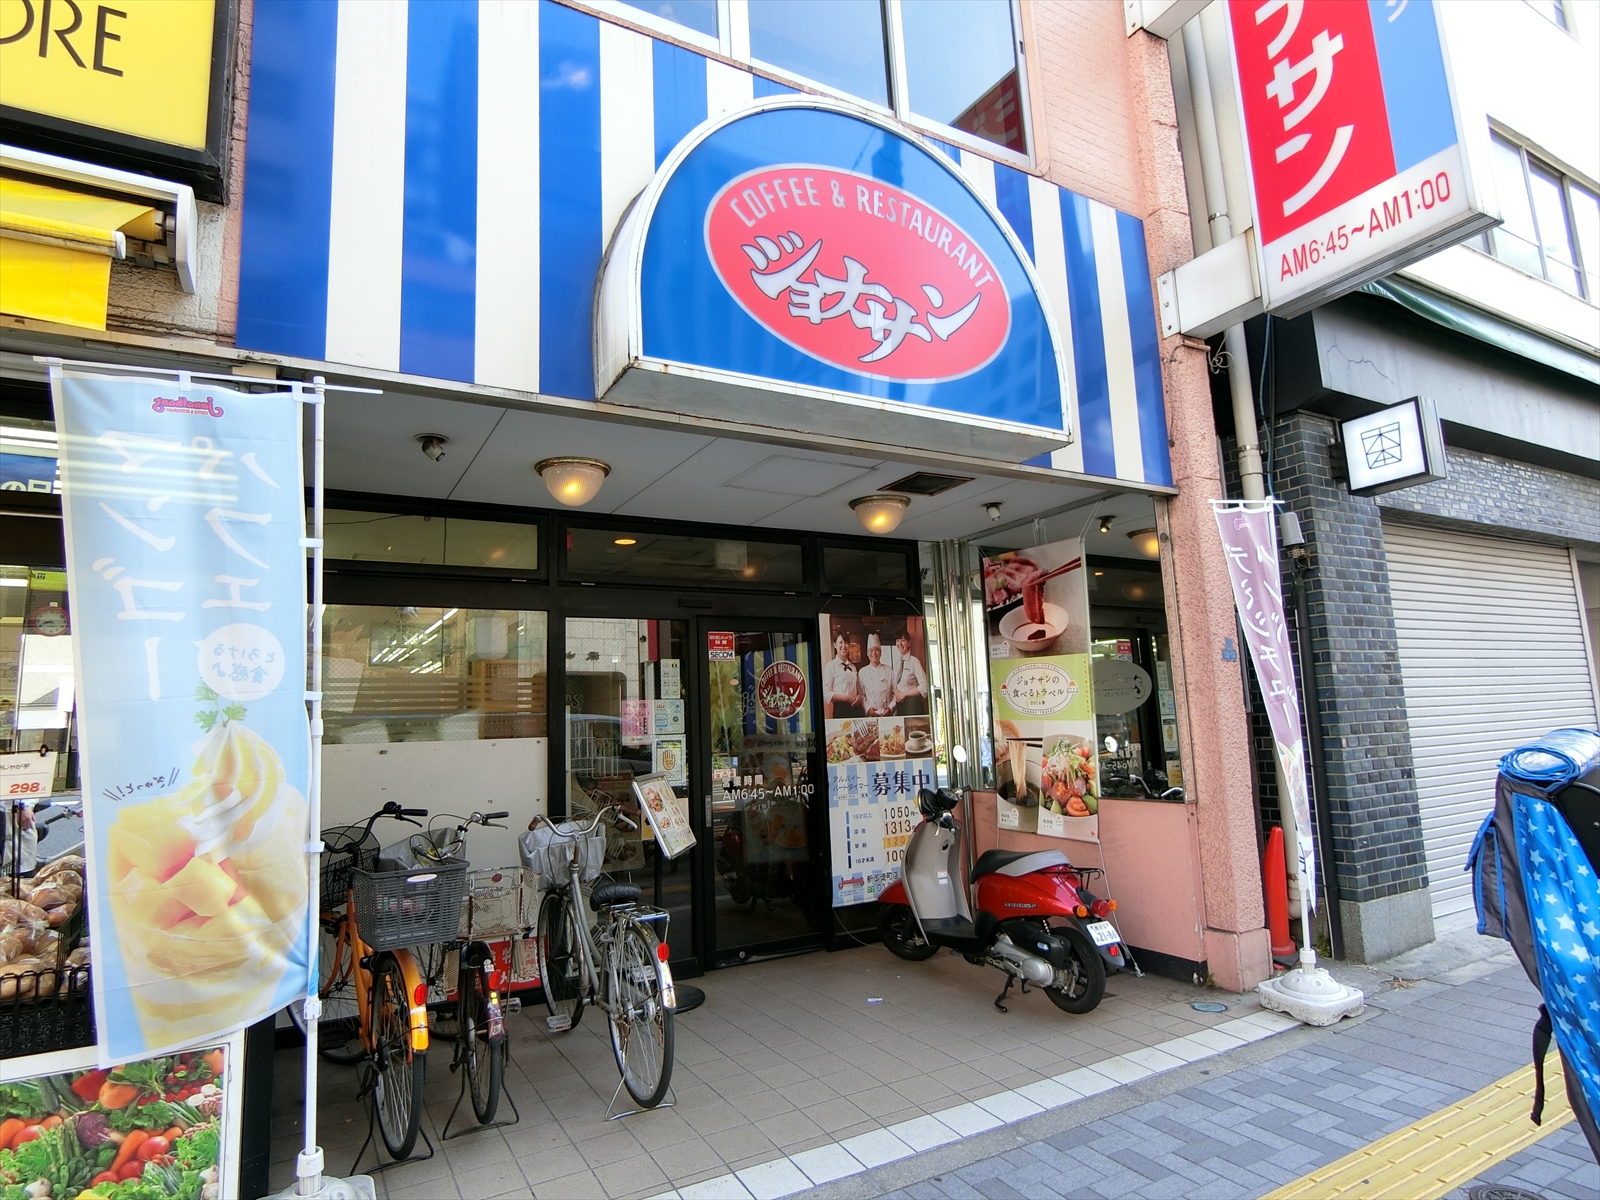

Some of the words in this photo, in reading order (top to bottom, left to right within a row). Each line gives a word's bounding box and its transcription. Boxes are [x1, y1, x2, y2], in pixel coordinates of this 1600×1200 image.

[729, 176, 821, 228] COFFEE
[830, 179, 846, 208] &
[856, 184, 994, 289] RESTAURANT
[740, 230, 982, 363] ジョナサン
[1016, 675, 1060, 686] ジョナサンの
[1012, 688, 1065, 698] 食べるトラベル
[722, 774, 764, 788] 営業時間
[833, 775, 861, 783] アルバイト
[872, 769, 930, 797] 募集中
[832, 782, 869, 792] パートタイマー
